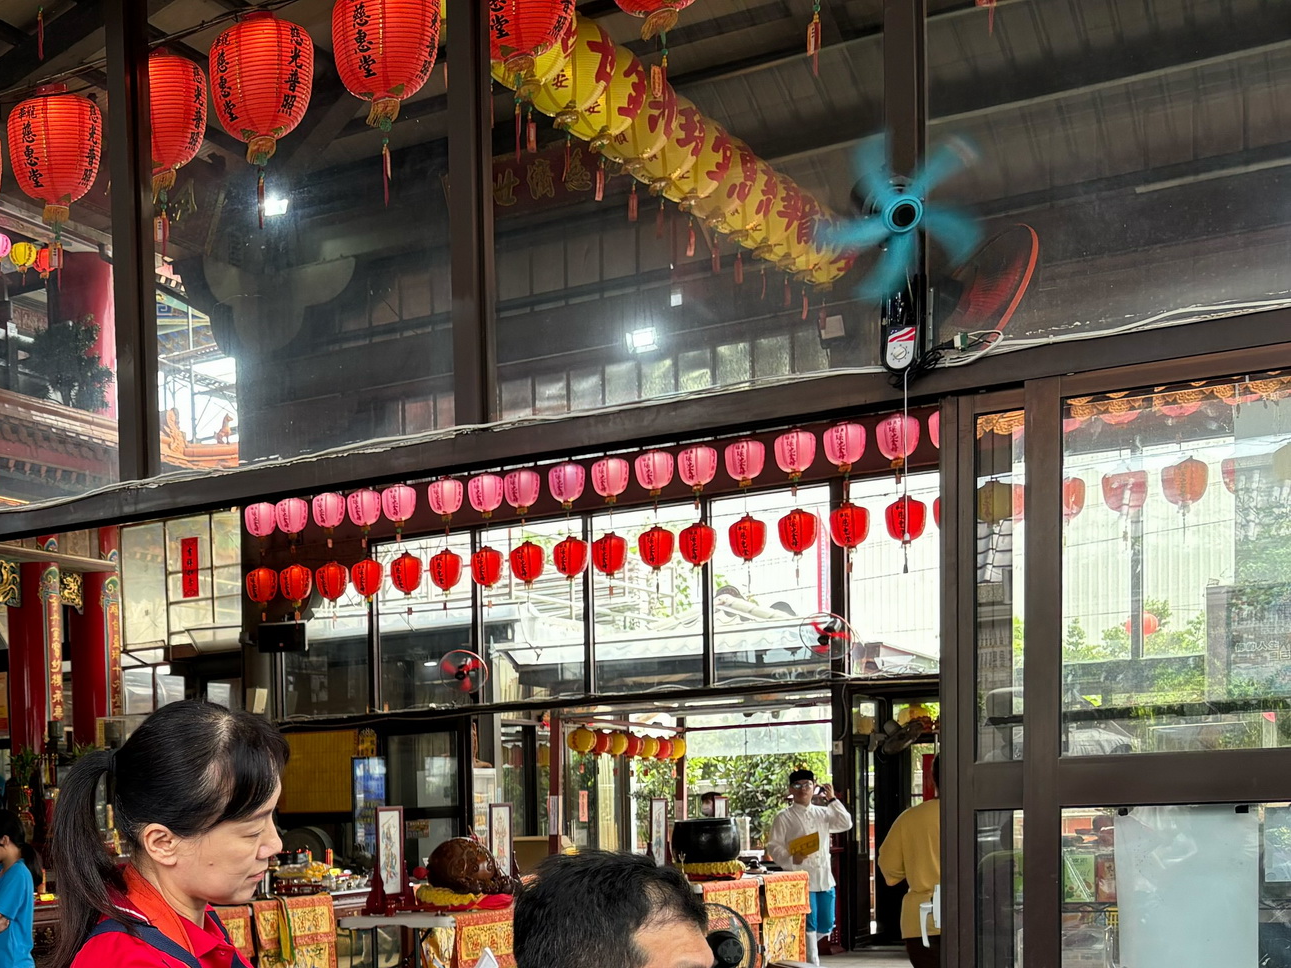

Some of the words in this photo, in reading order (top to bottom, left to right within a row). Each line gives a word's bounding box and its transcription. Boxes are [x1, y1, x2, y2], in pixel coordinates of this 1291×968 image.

[276, 25, 304, 117] 慈光普照
[77, 103, 99, 188] 慈光普照
